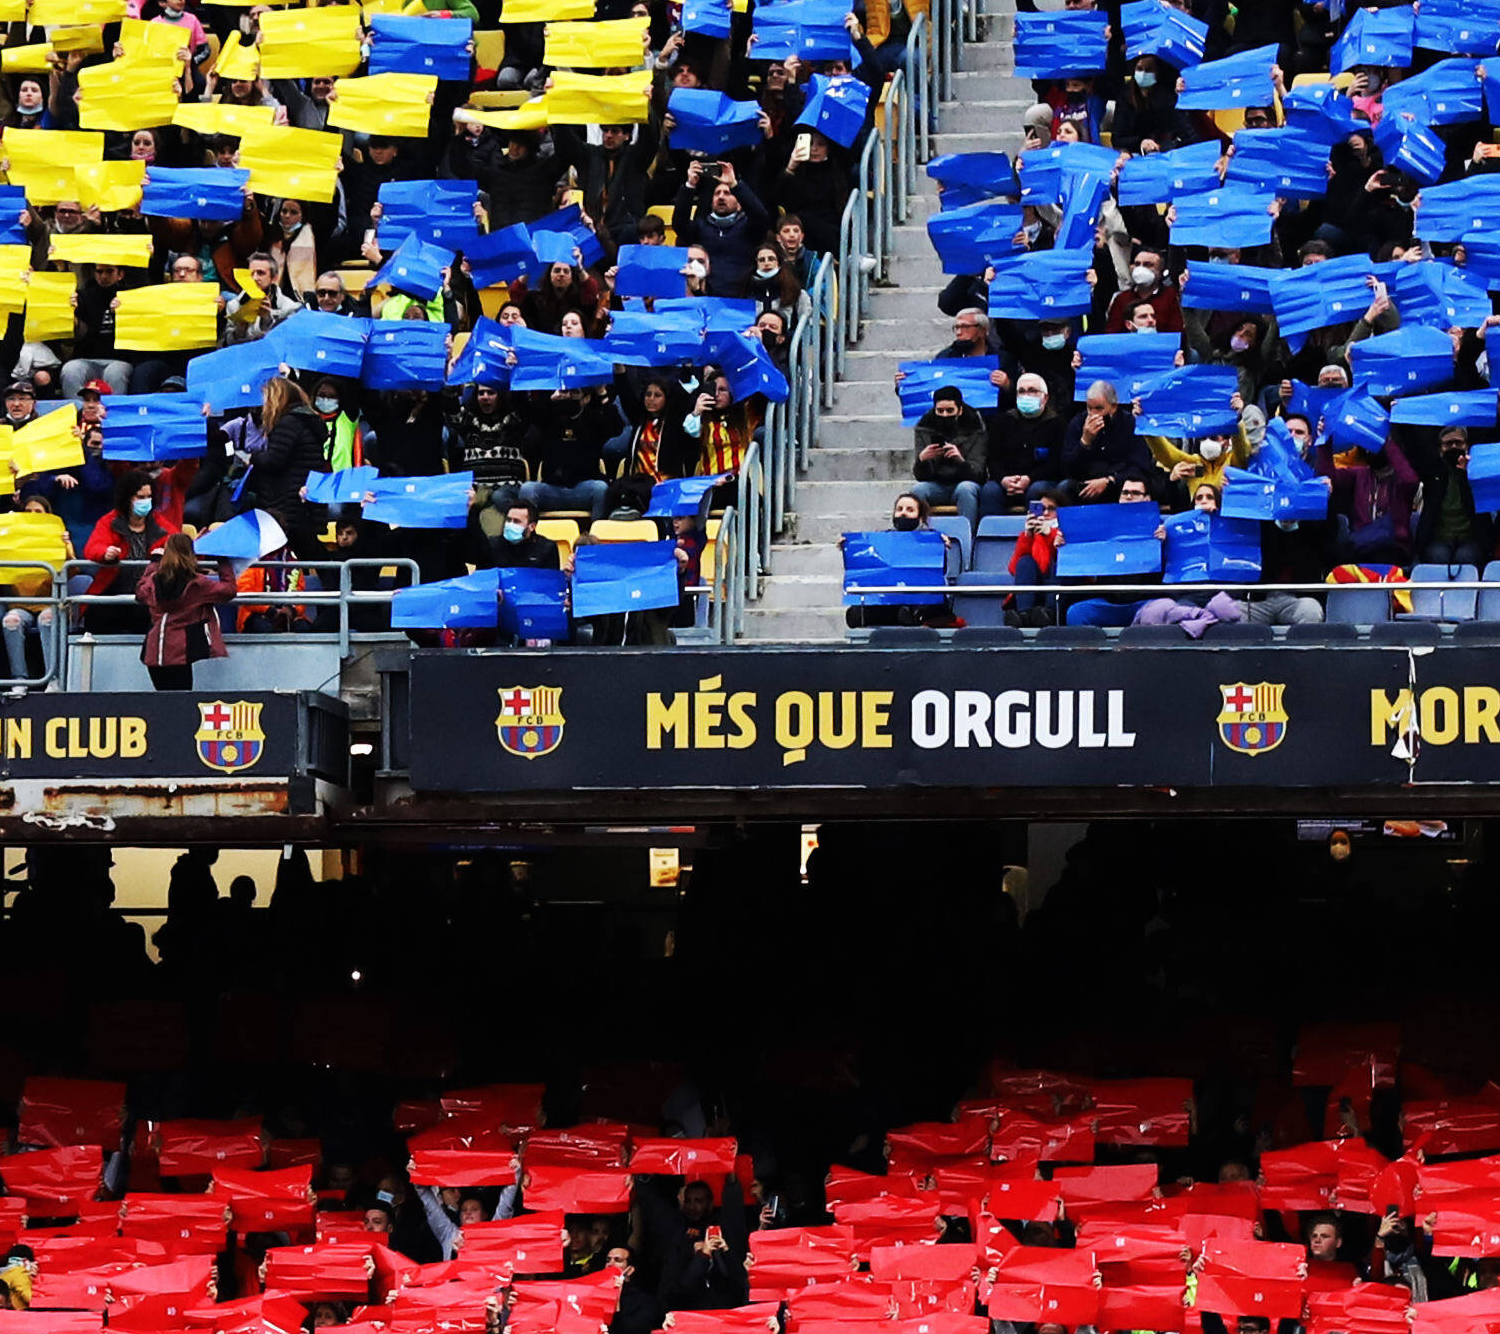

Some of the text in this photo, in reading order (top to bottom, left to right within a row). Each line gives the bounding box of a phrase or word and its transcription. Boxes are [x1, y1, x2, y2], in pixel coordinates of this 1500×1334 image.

[46, 716, 147, 759] CLUB
[646, 674, 1136, 767] MÉS QUE ORGULL
